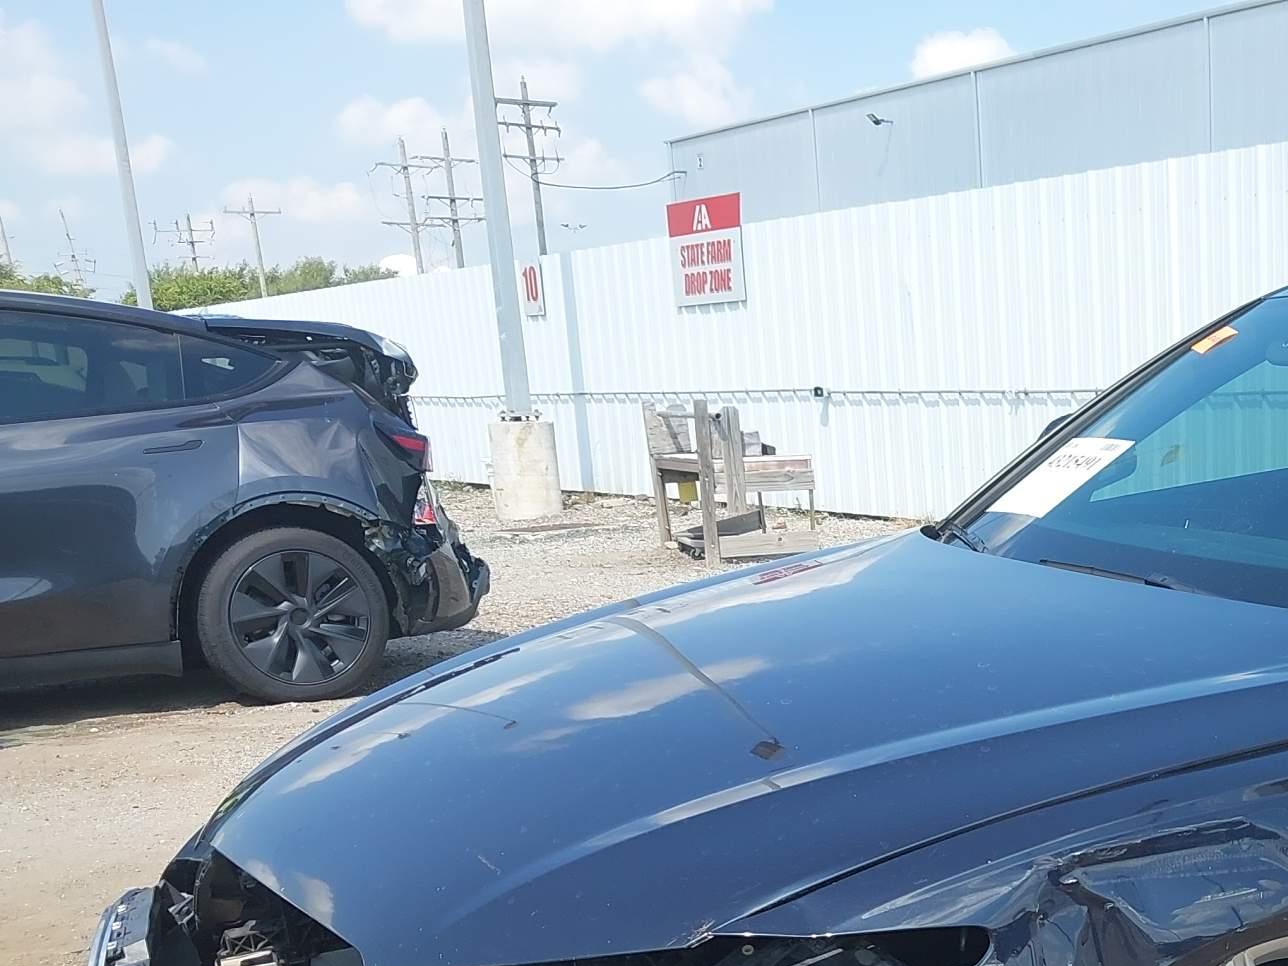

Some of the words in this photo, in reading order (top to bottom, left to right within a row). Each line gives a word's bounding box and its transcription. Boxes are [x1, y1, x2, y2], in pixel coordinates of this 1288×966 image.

[680, 242, 706, 269] STATE
[707, 239, 732, 265] FARM
[521, 265, 539, 302] 10
[684, 271, 708, 296] DROP
[709, 268, 733, 294] ZONE
